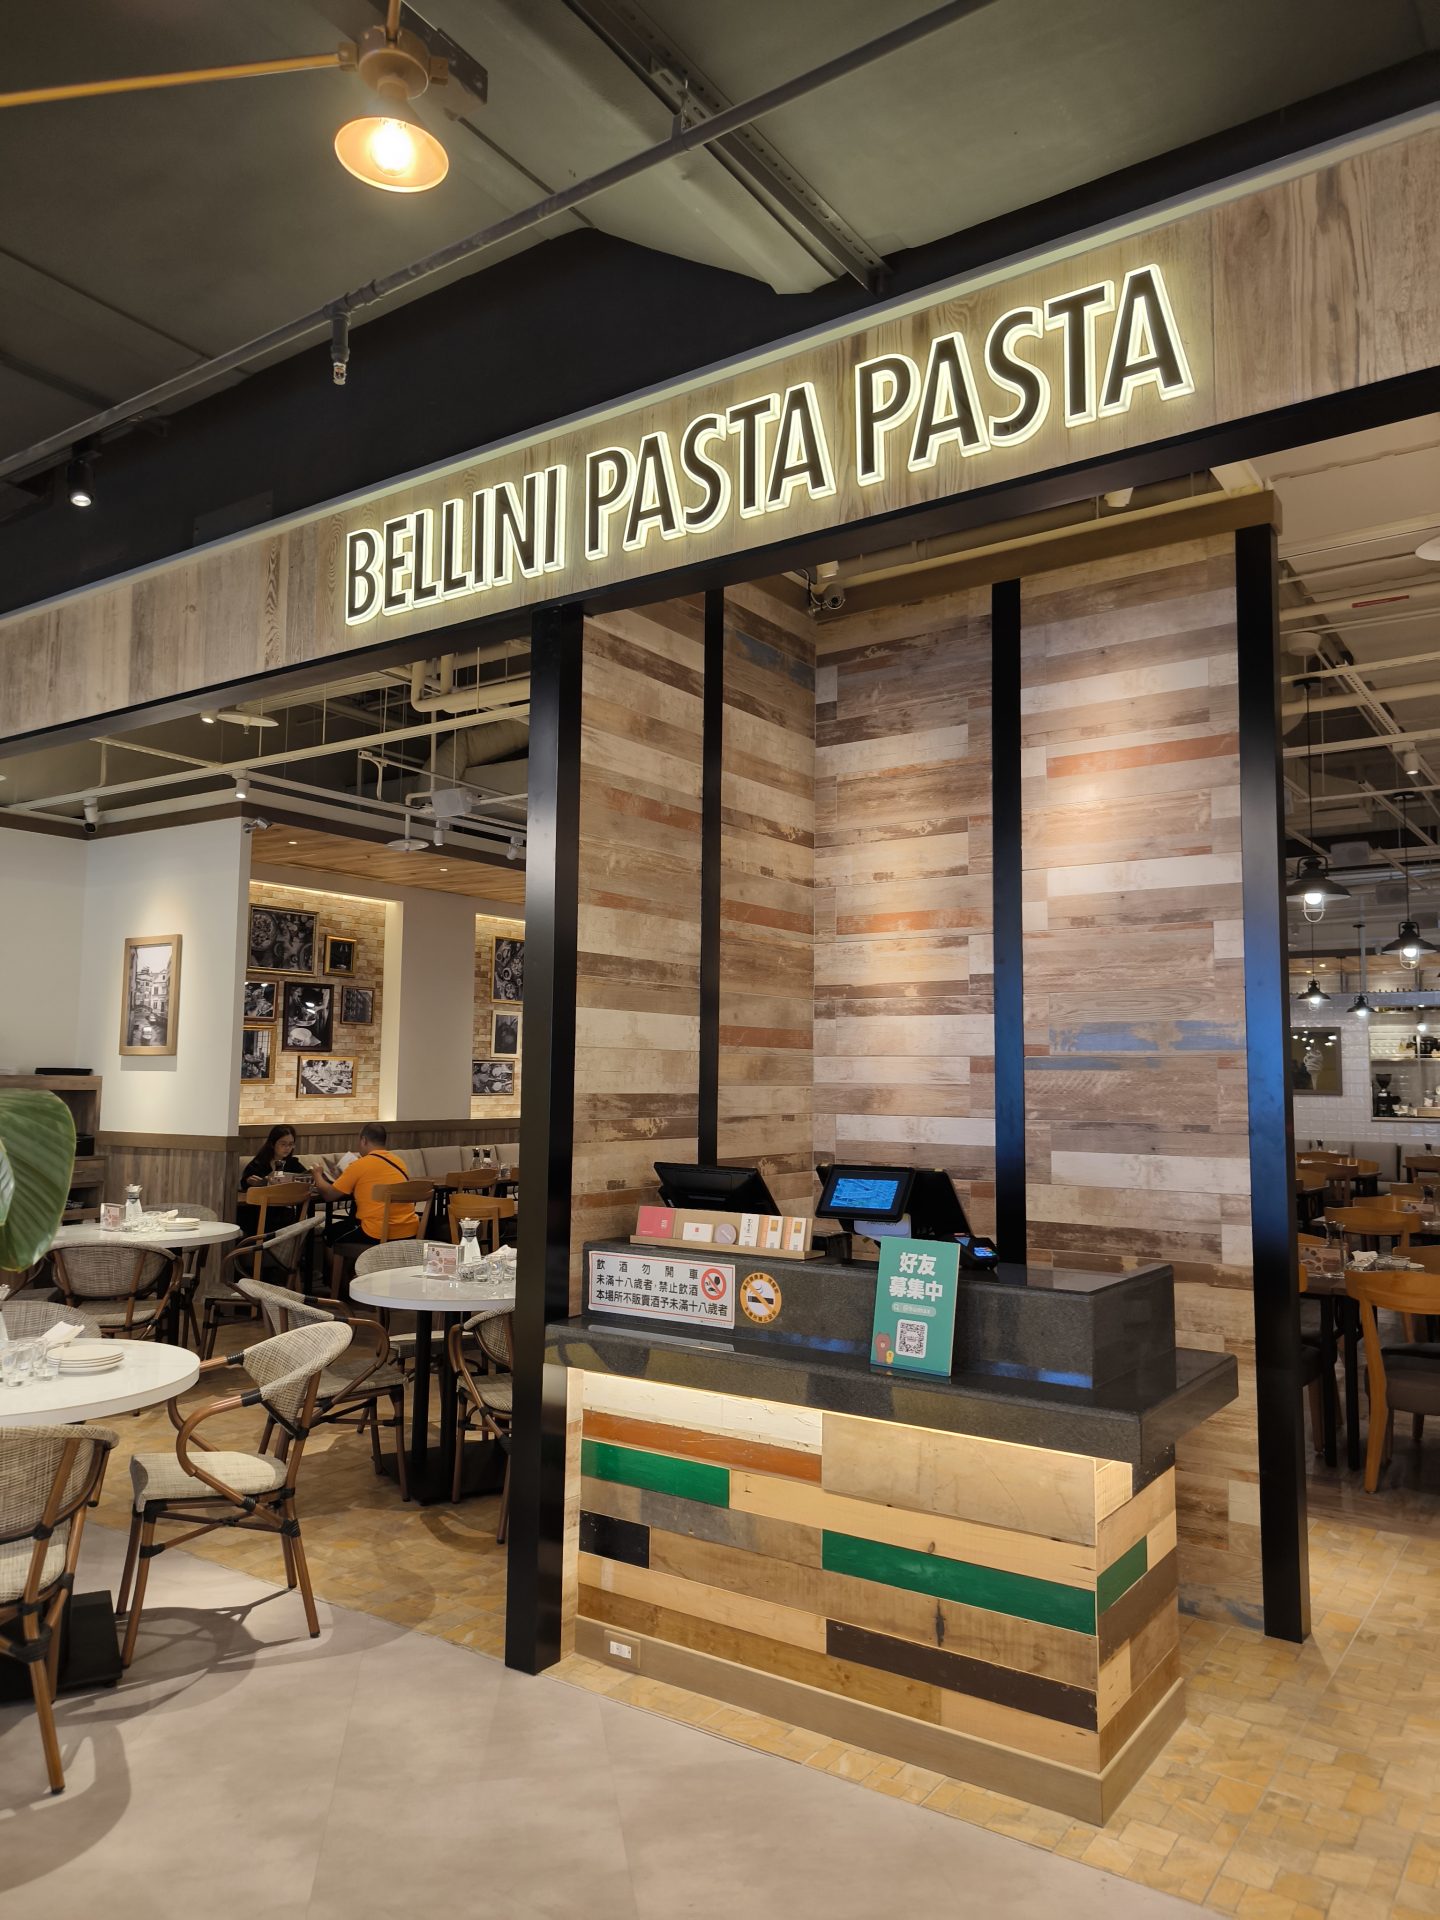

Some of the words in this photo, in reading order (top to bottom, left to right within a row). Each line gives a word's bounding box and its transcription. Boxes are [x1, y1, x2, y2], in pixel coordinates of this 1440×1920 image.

[345, 463, 568, 627] BELLINI
[586, 381, 837, 561] PASTA
[856, 263, 1196, 486] PASTA
[596, 1259, 699, 1280] 飲酒勿開車
[899, 1252, 936, 1276] 好友
[889, 1276, 943, 1302] 募集中
[595, 1289, 728, 1317] 本場所不販賣酒予未滿十八歲者
